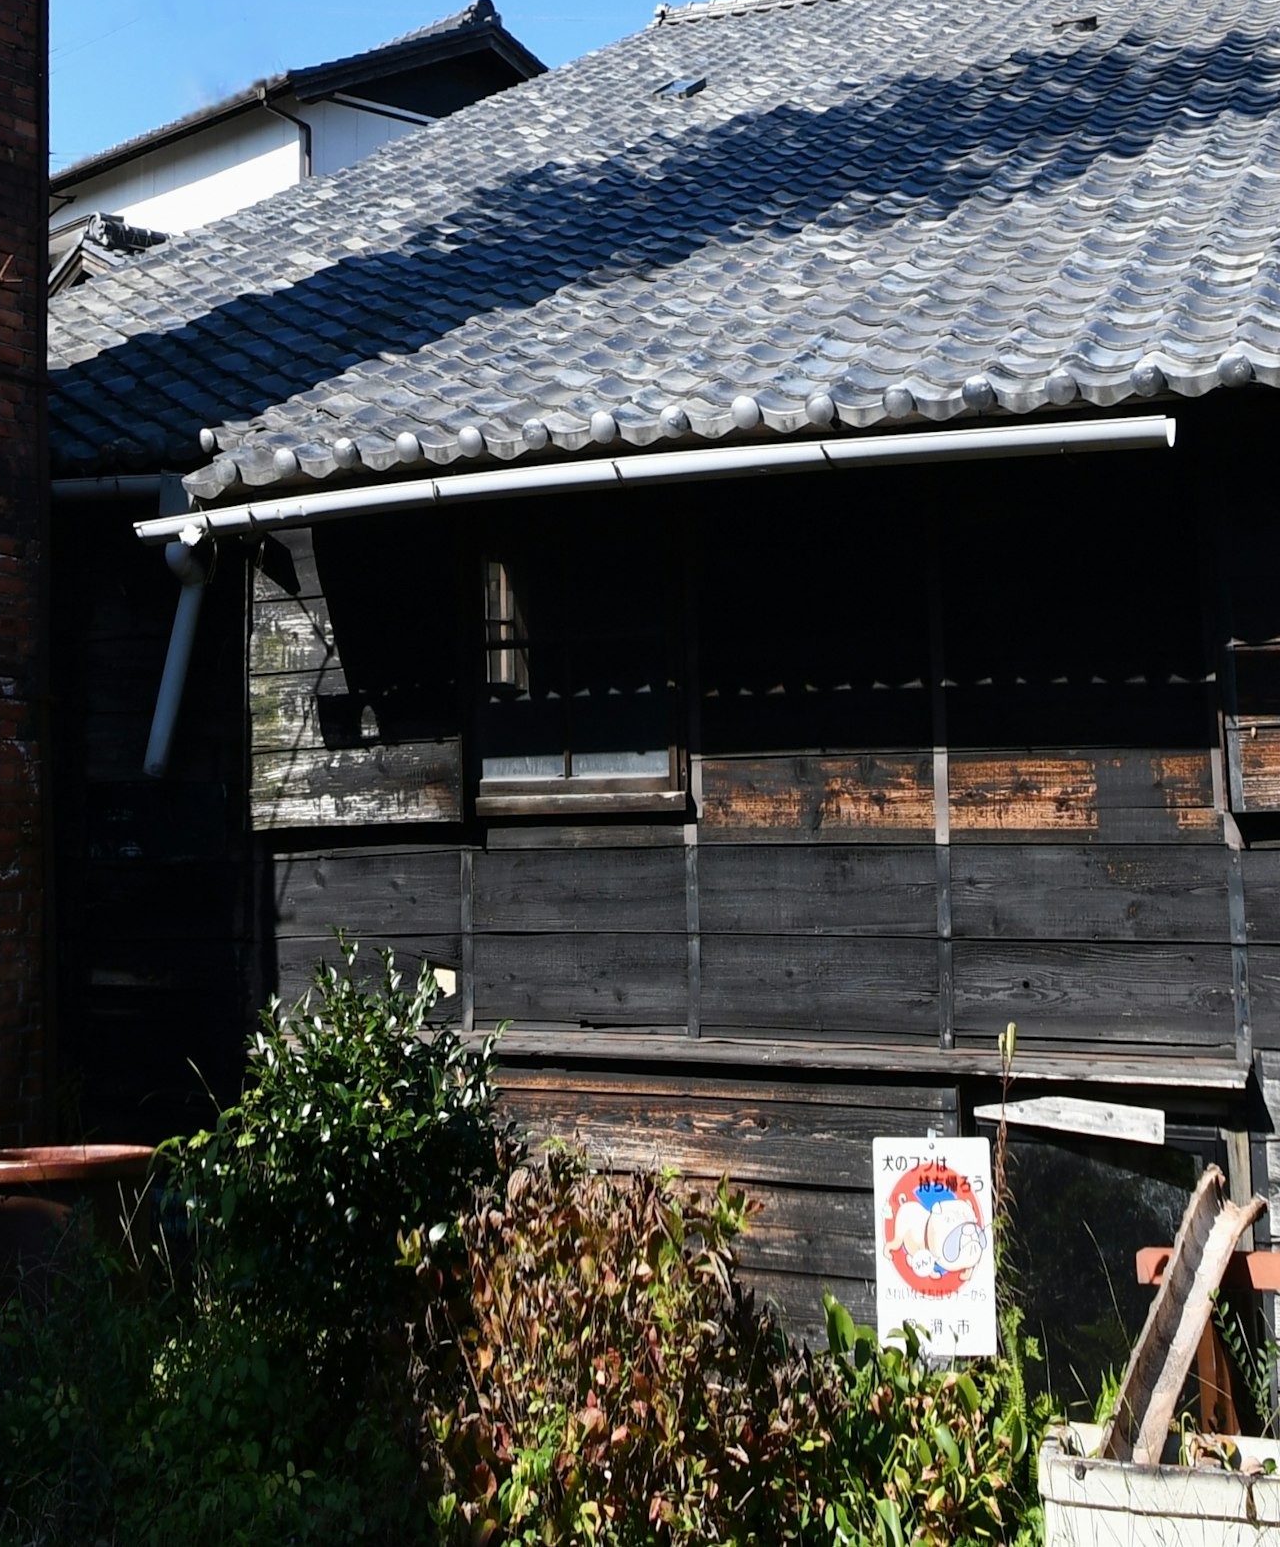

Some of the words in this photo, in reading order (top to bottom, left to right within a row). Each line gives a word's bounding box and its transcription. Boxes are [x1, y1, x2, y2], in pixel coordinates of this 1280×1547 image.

[882, 1154, 949, 1172] 犬のフンは
[918, 1174, 985, 1193] 持ち帰ろう
